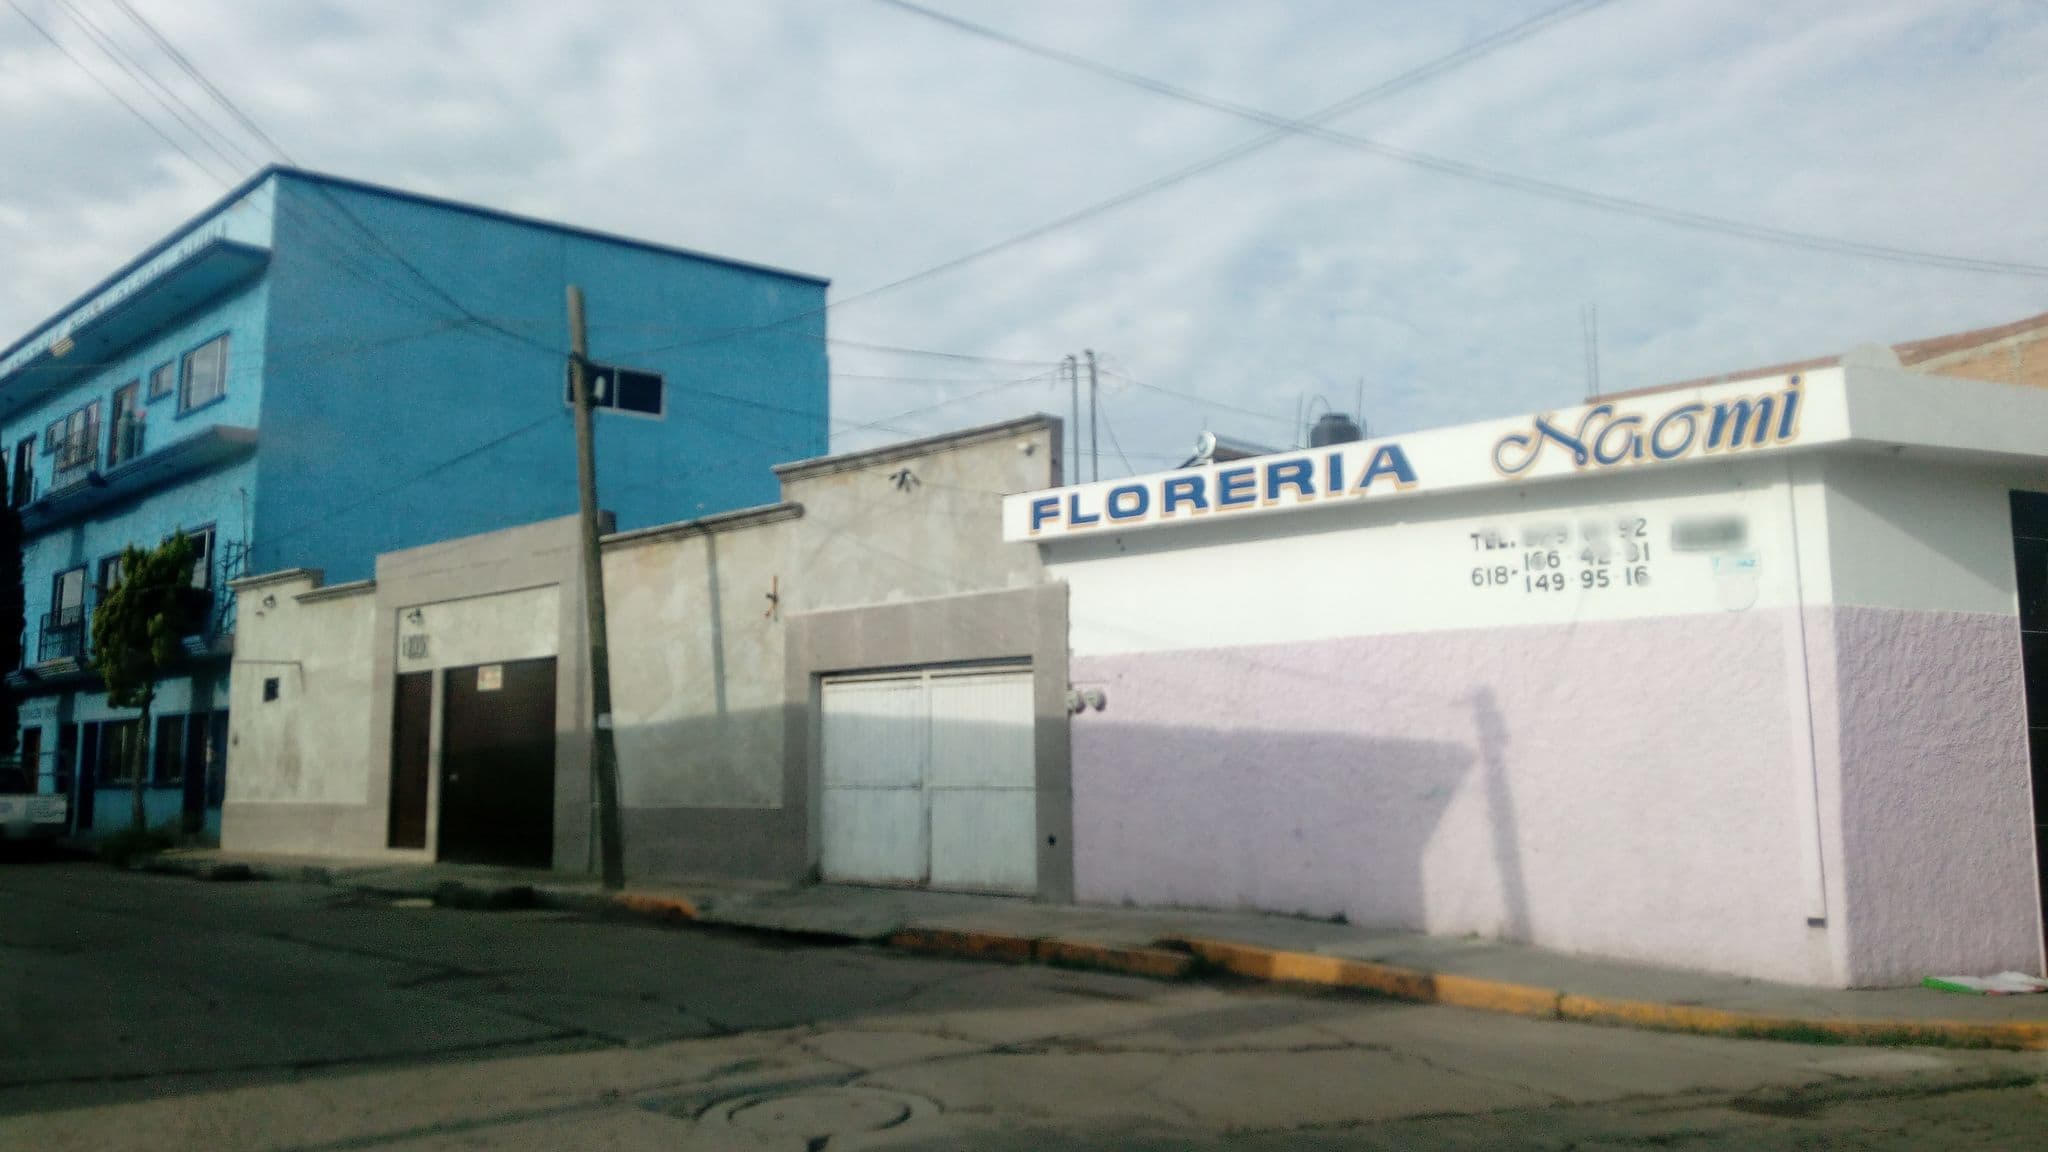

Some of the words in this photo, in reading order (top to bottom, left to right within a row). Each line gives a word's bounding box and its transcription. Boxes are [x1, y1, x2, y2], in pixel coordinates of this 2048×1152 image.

[1030, 443, 1419, 535] FLORERIA
[1493, 374, 1803, 476] Naomi
[1526, 573, 1565, 593] 149
[1580, 569, 1610, 589] 95
